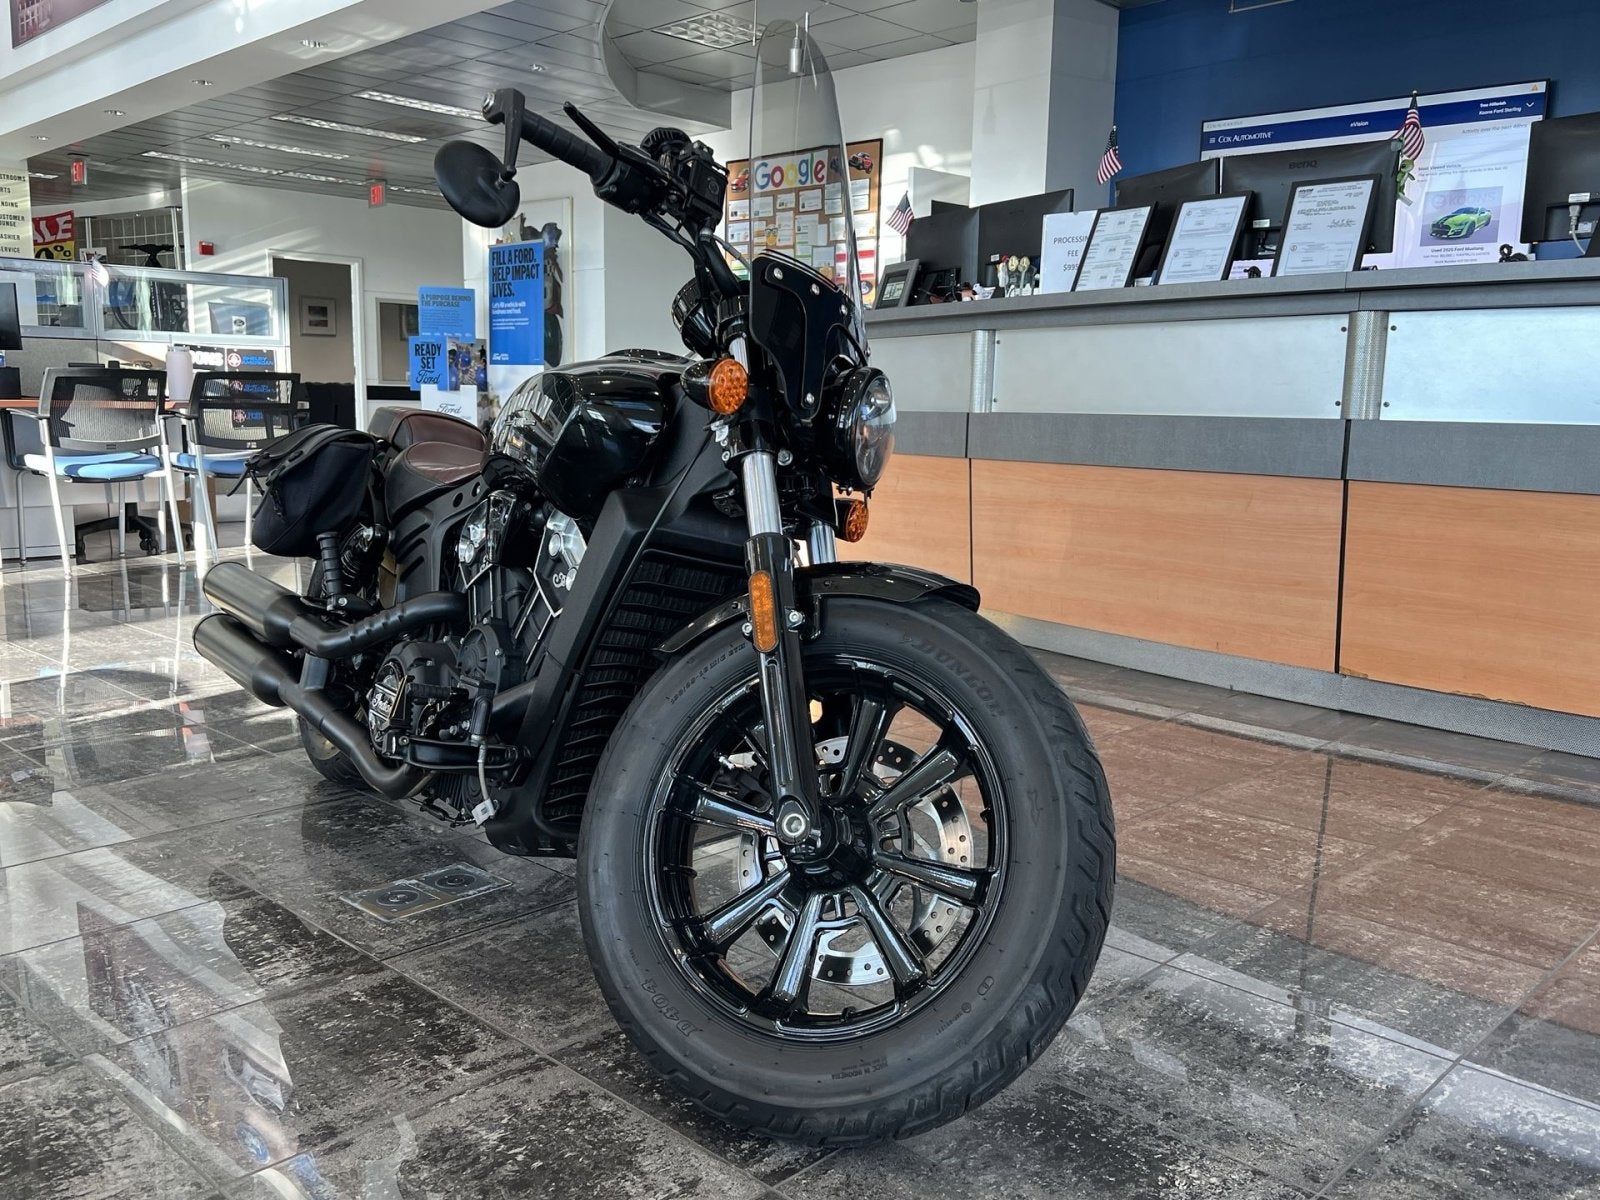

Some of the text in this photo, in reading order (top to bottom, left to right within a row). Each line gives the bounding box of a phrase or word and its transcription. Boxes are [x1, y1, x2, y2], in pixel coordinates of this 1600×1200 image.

[755, 151, 826, 190] Google
[1053, 235, 1089, 244] PROCESSIN
[492, 247, 537, 266] FILL A FORD.
[1067, 249, 1079, 257] FEE
[492, 264, 540, 283] HELP IMPACT
[492, 282, 515, 298] LIVES.
[415, 344, 441, 357] READY
[421, 357, 436, 369] SET
[416, 369, 441, 384] Ford
[438, 403, 462, 413] Ford
[641, 979, 698, 1037] D404
